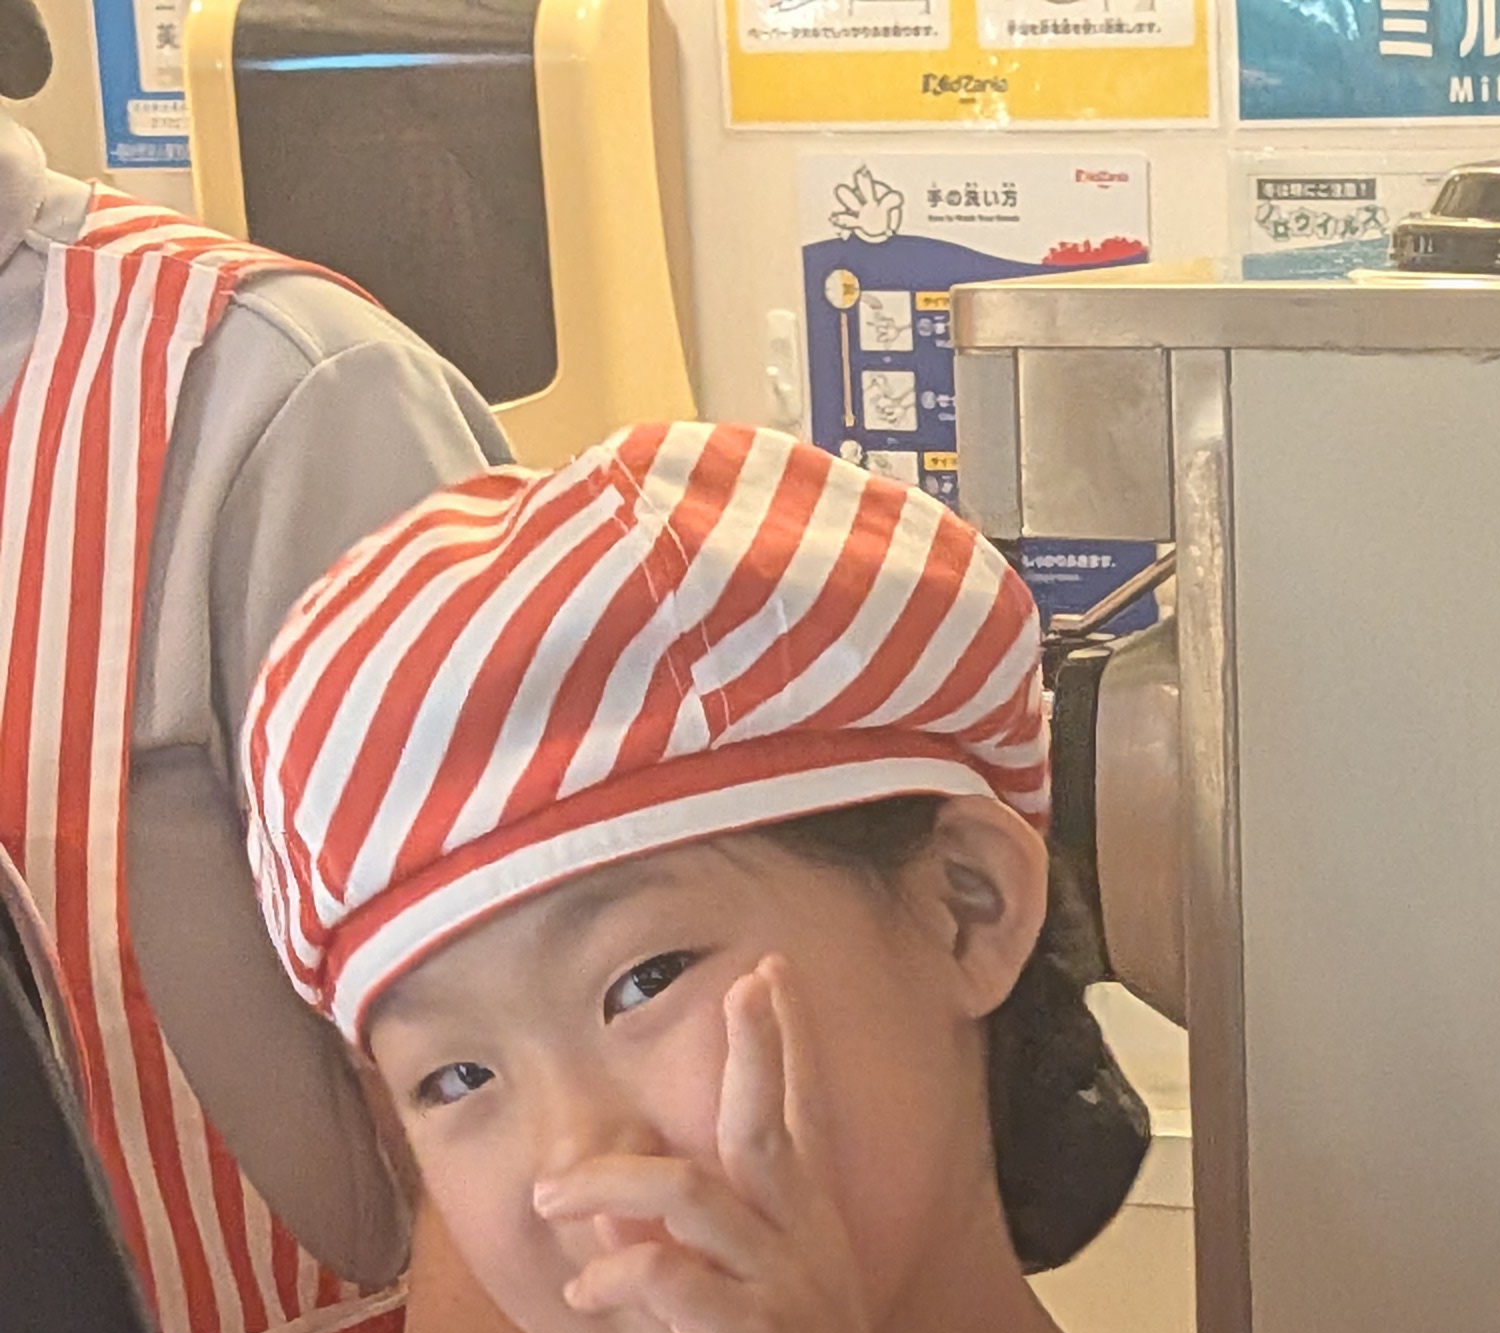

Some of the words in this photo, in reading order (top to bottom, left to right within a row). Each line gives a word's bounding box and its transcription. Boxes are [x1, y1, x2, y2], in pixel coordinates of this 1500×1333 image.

[1258, 203, 1385, 240] ノロウイルス
